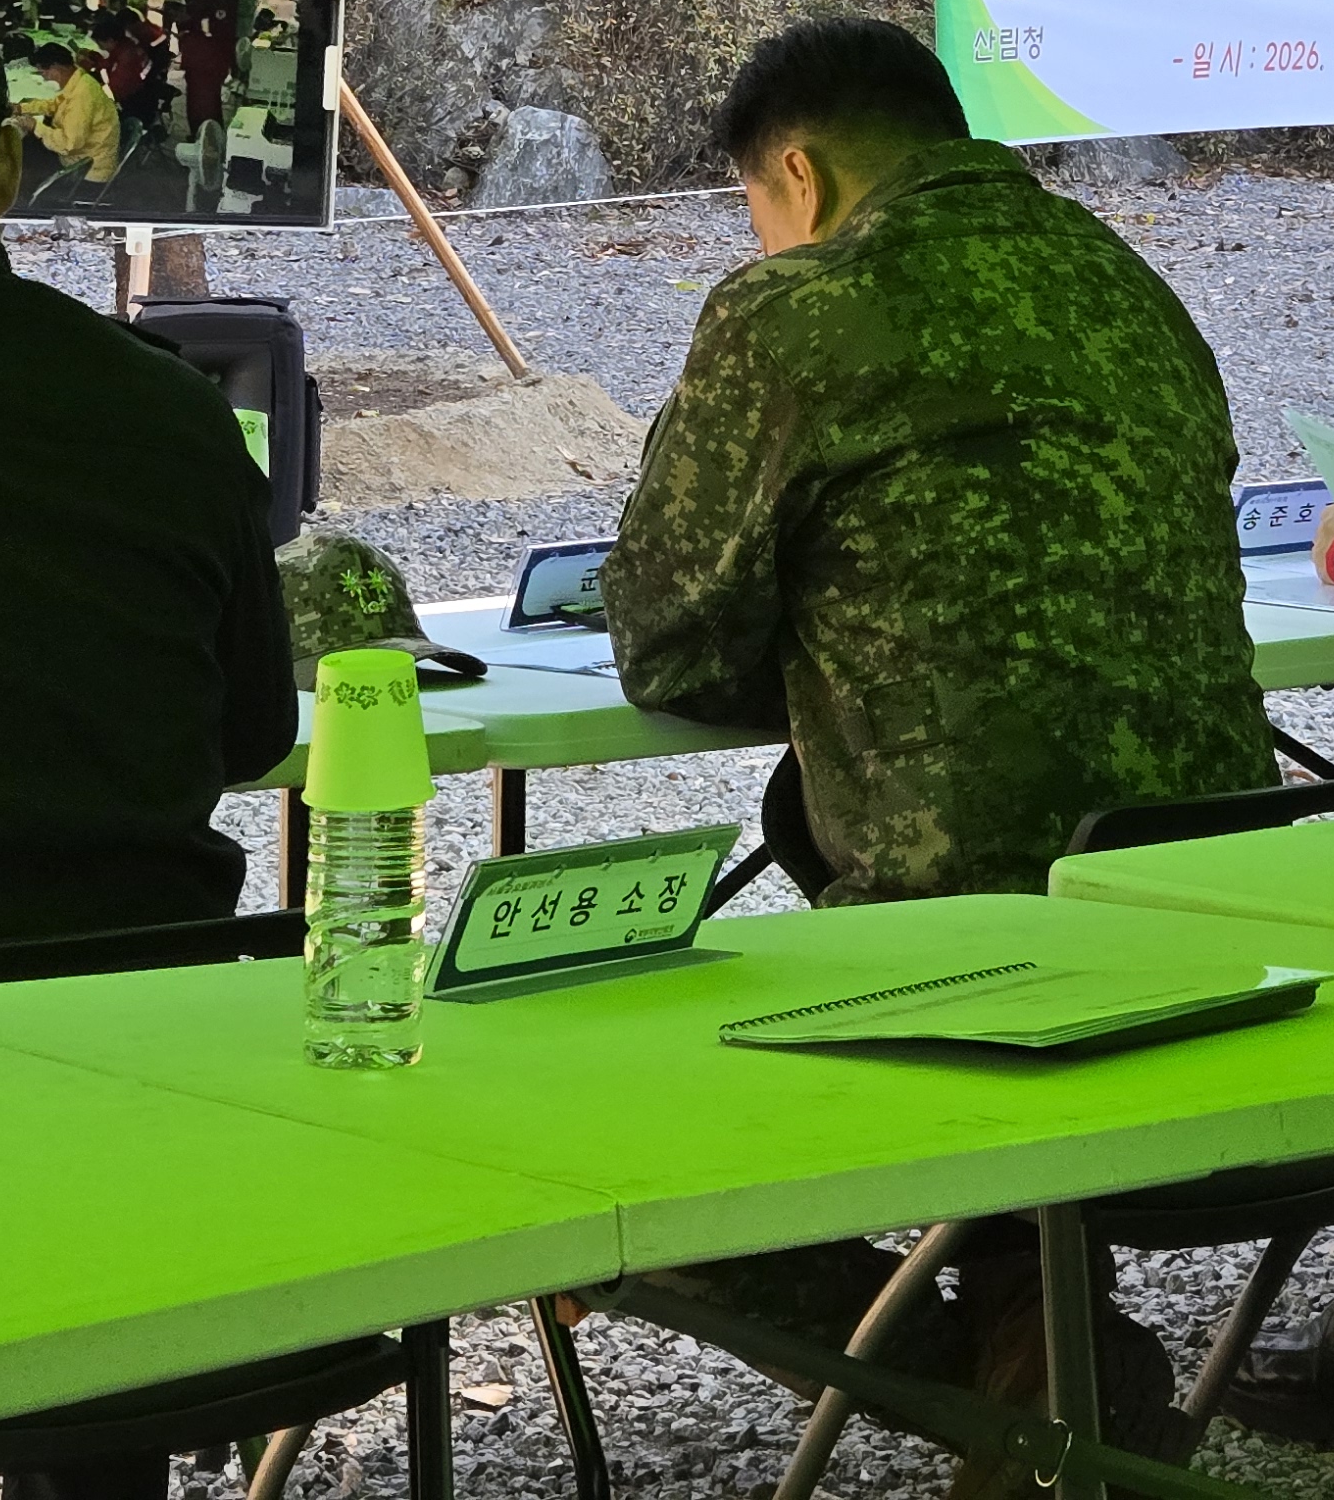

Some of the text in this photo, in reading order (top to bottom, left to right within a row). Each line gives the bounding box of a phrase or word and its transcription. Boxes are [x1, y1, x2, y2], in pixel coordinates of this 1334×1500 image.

[973, 25, 1044, 63] 산림청
[1263, 40, 1325, 72] 2026.
[489, 871, 688, 940] 안선용 소장
